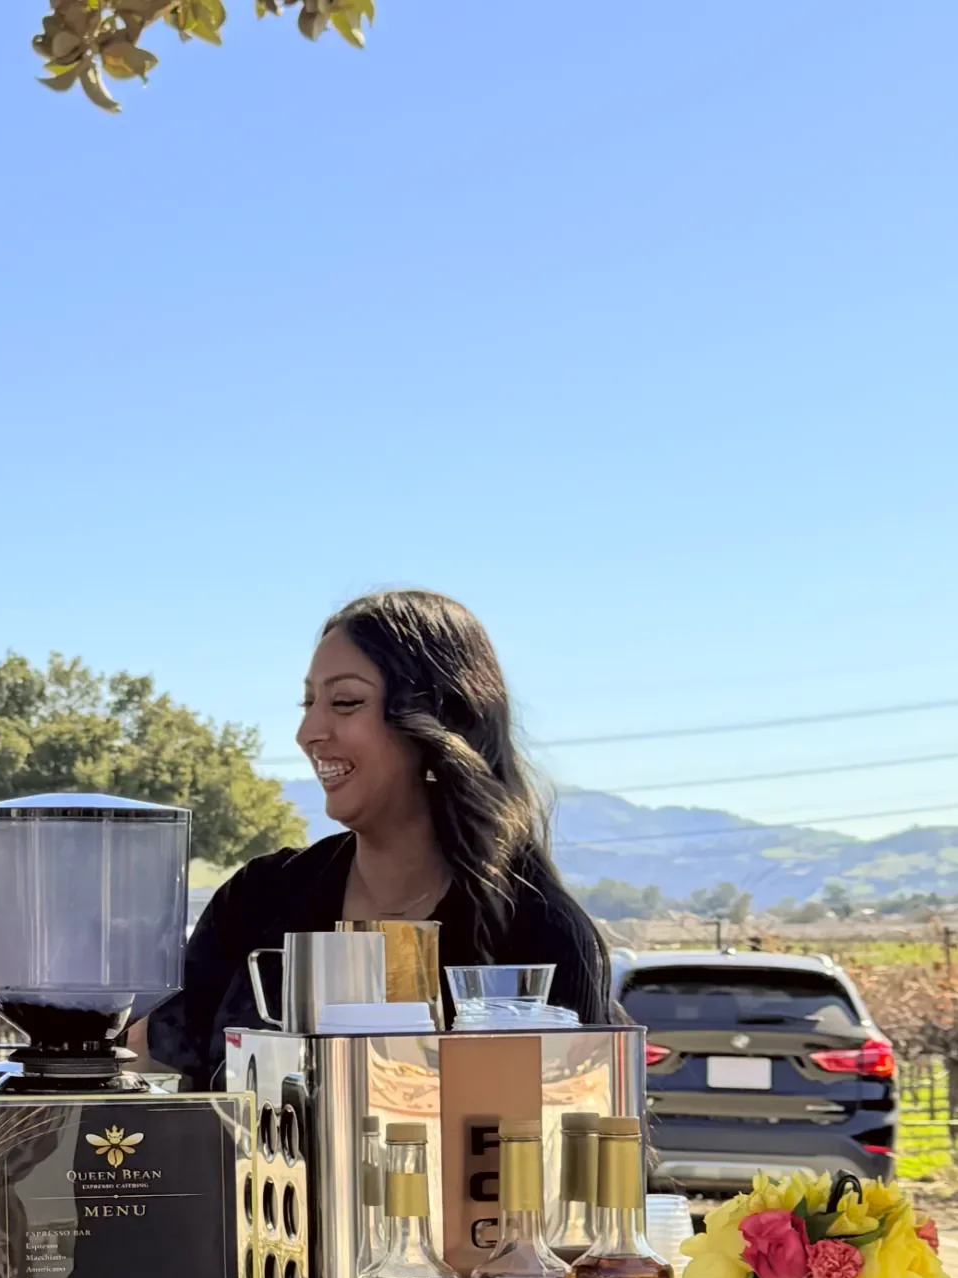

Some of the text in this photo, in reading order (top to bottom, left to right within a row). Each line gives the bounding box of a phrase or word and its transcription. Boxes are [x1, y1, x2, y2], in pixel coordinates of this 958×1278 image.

[66, 1169, 162, 1183] QUEEN BEAN
[84, 1205, 147, 1217] MENU
[25, 1229, 91, 1238] ESPRESSO BAR
[25, 1242, 59, 1251] Espresso
[25, 1253, 67, 1261] Macchiato
